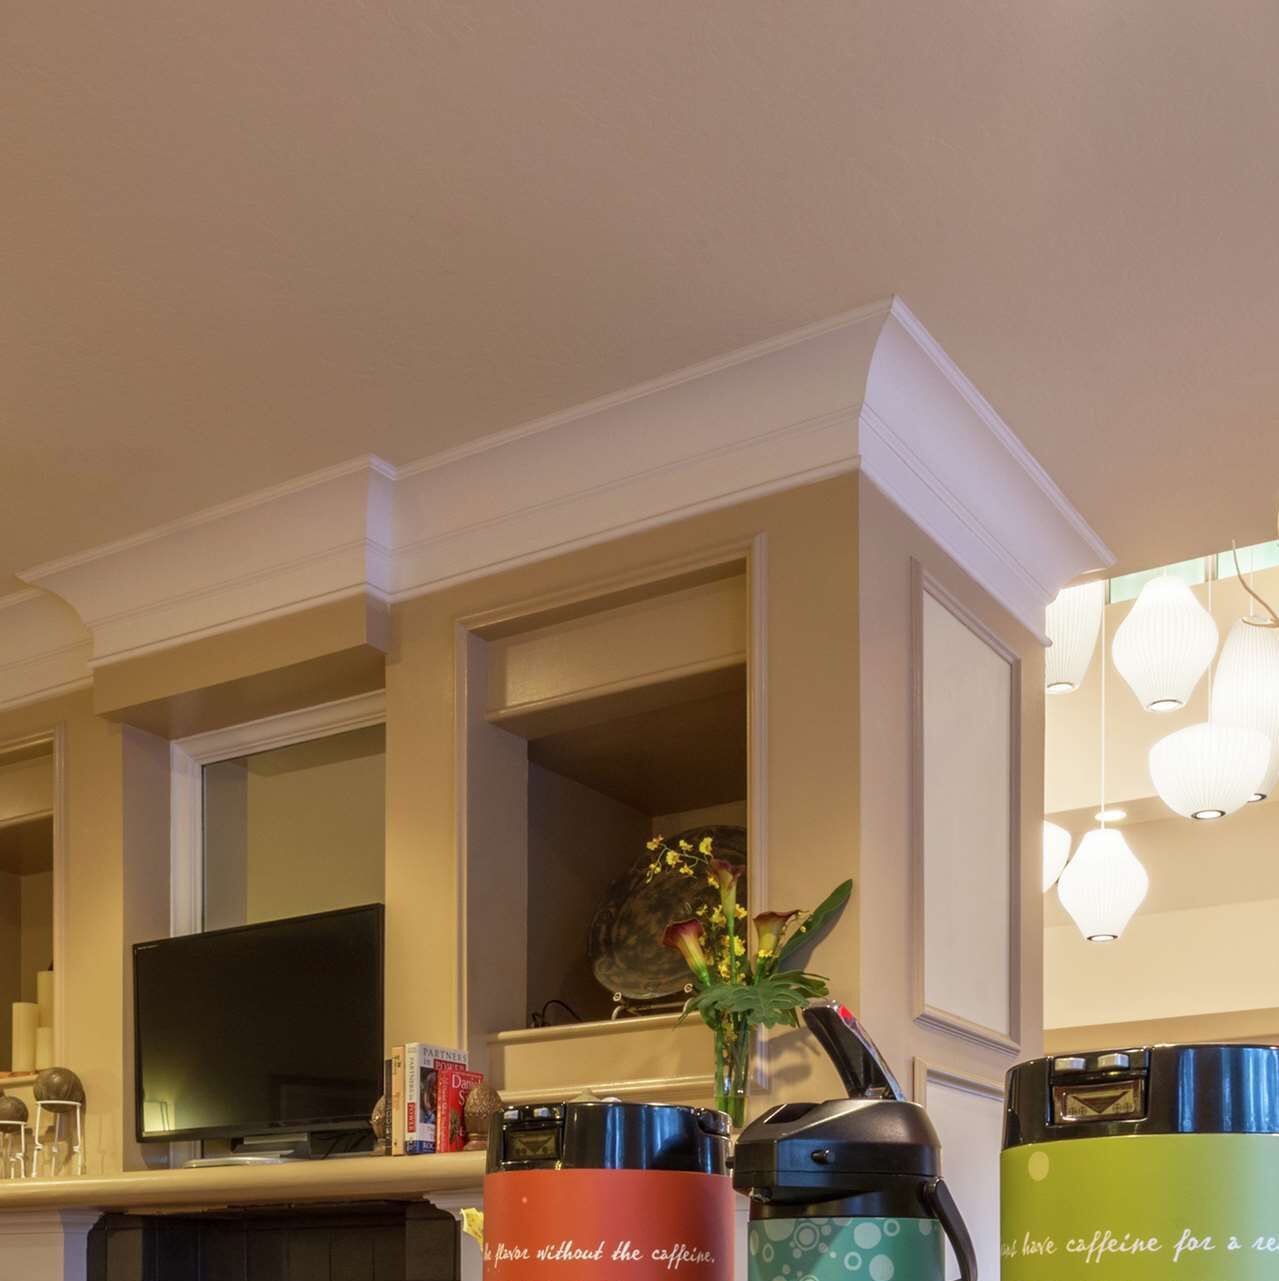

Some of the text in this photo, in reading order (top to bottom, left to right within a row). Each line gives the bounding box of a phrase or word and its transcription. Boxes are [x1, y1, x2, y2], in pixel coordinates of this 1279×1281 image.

[423, 1047, 469, 1062] PARTNERS
[494, 1242, 531, 1269] flavor
[536, 1240, 605, 1262] without
[611, 1240, 643, 1261] the
[651, 1243, 716, 1270] caffeine.
[1022, 1231, 1058, 1256] have
[1065, 1230, 1162, 1263] caffeine
[1173, 1228, 1216, 1263] for
[1227, 1235, 1241, 1250] a
